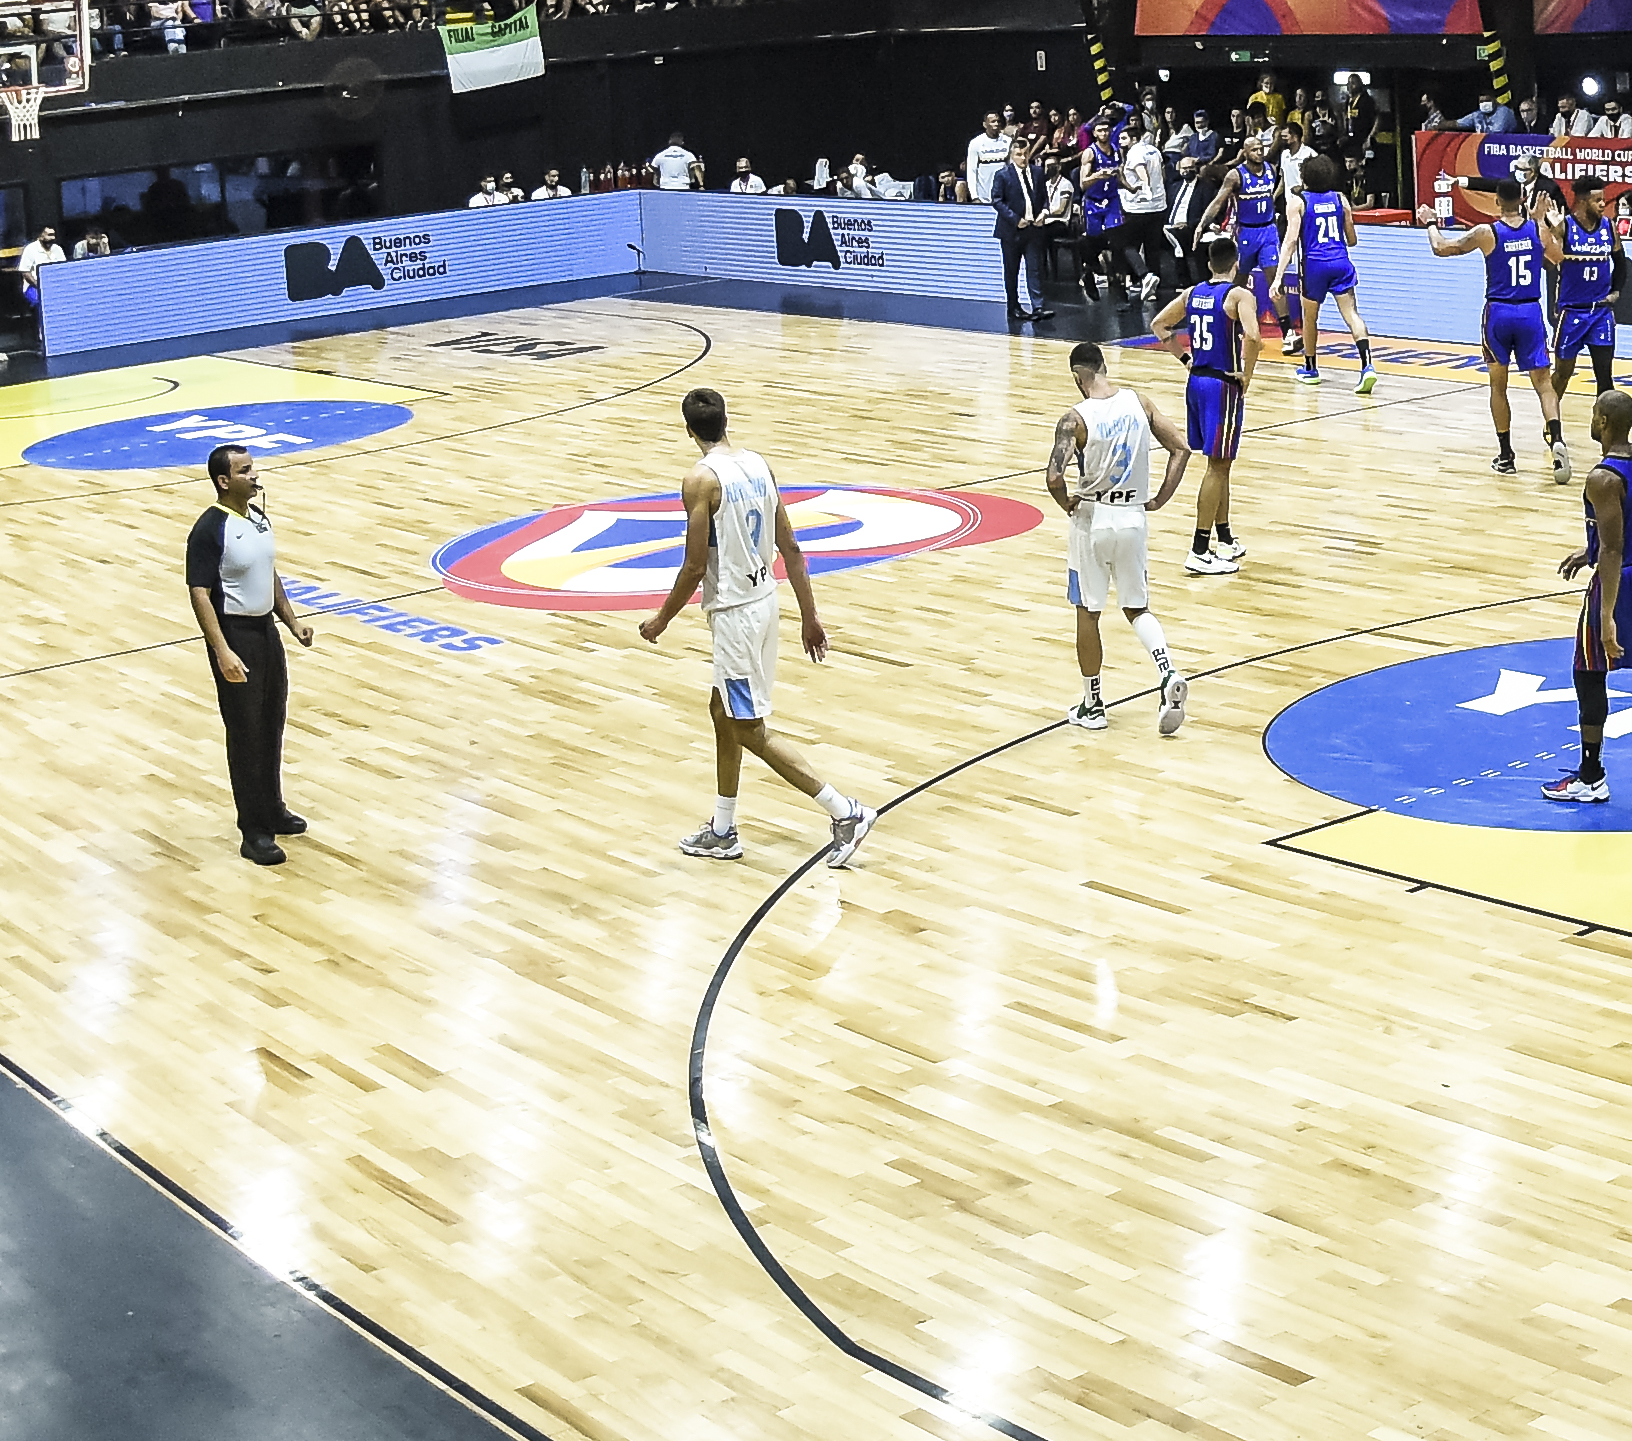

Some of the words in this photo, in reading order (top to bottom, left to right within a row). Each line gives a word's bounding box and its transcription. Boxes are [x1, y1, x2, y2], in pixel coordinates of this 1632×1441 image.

[491, 16, 529, 38] CAPITAL
[1484, 144, 1507, 156] FIBA
[1509, 144, 1573, 160] BASKETBALL
[1576, 148, 1612, 161] WORLD
[831, 215, 874, 232] Buenos
[1315, 215, 1341, 244] 24
[372, 233, 431, 251] Buenos
[838, 233, 870, 249] Aires
[384, 250, 428, 267] Aires
[843, 250, 885, 268] Ciudad
[390, 259, 448, 282] Ciudad
[1507, 255, 1533, 286] 15
[1190, 315, 1214, 350] 35
[428, 331, 608, 360] VISA
[145, 414, 314, 449] YPF
[1109, 443, 1132, 485] 3
